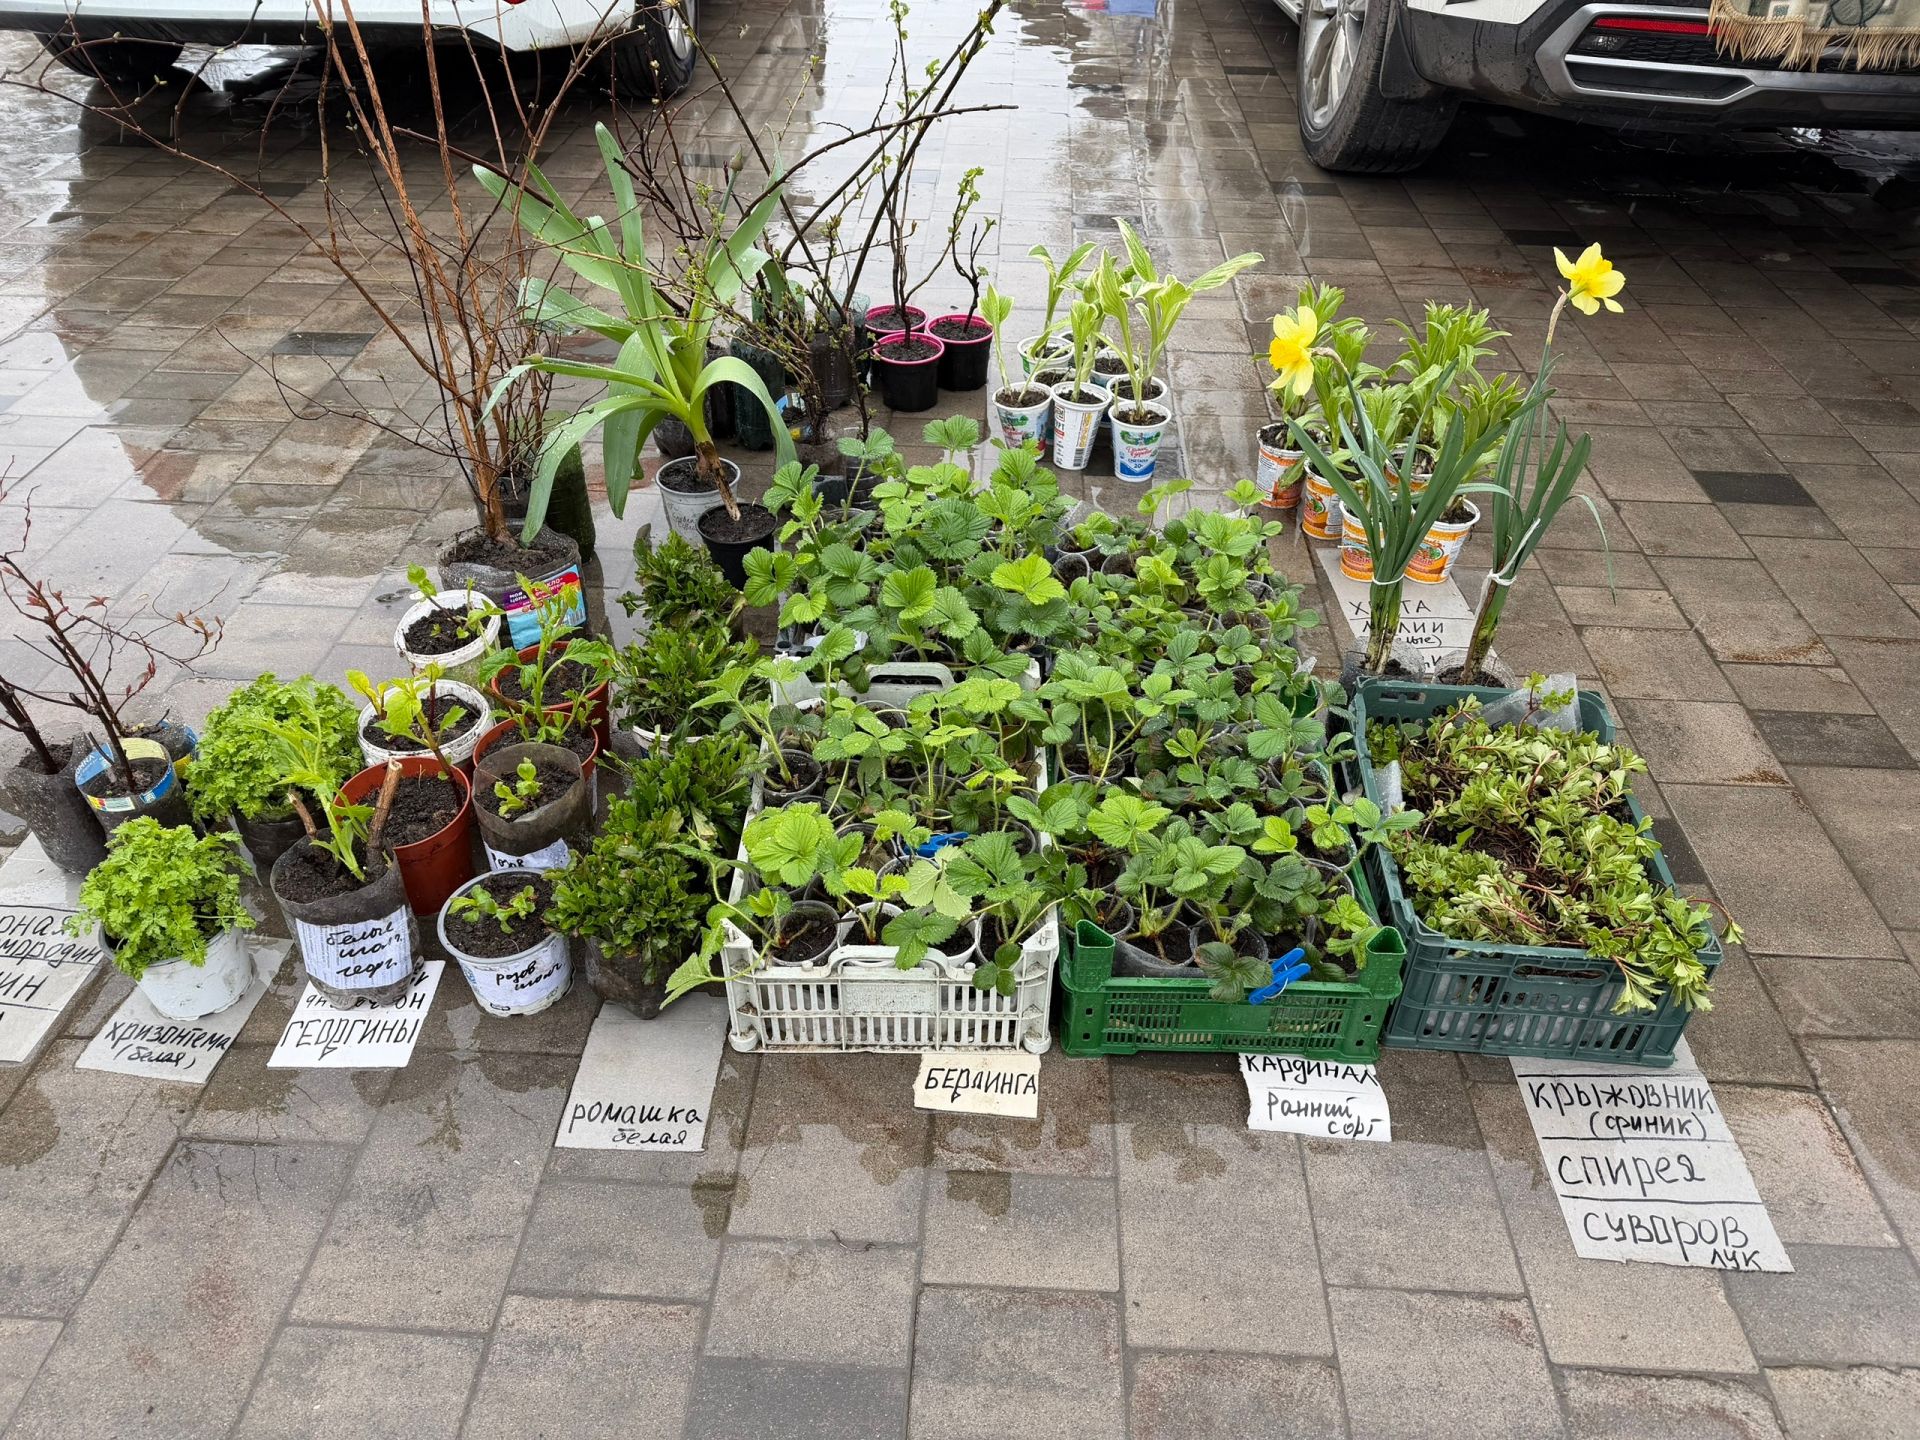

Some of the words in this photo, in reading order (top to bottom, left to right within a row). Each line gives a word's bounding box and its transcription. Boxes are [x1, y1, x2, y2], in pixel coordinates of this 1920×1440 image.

[1348, 599, 1432, 616] ХТА
[1362, 620, 1444, 634] ЛЛИИ
[280, 1018, 420, 1061] ГЕОРГИНЫ
[924, 1067, 1037, 1103] БЕРЛИНГА
[1528, 1081, 1715, 1117] КРЫЖОВНИК
[611, 1127, 688, 1145] белая
[1583, 1211, 1749, 1262] СУВОРОВ
